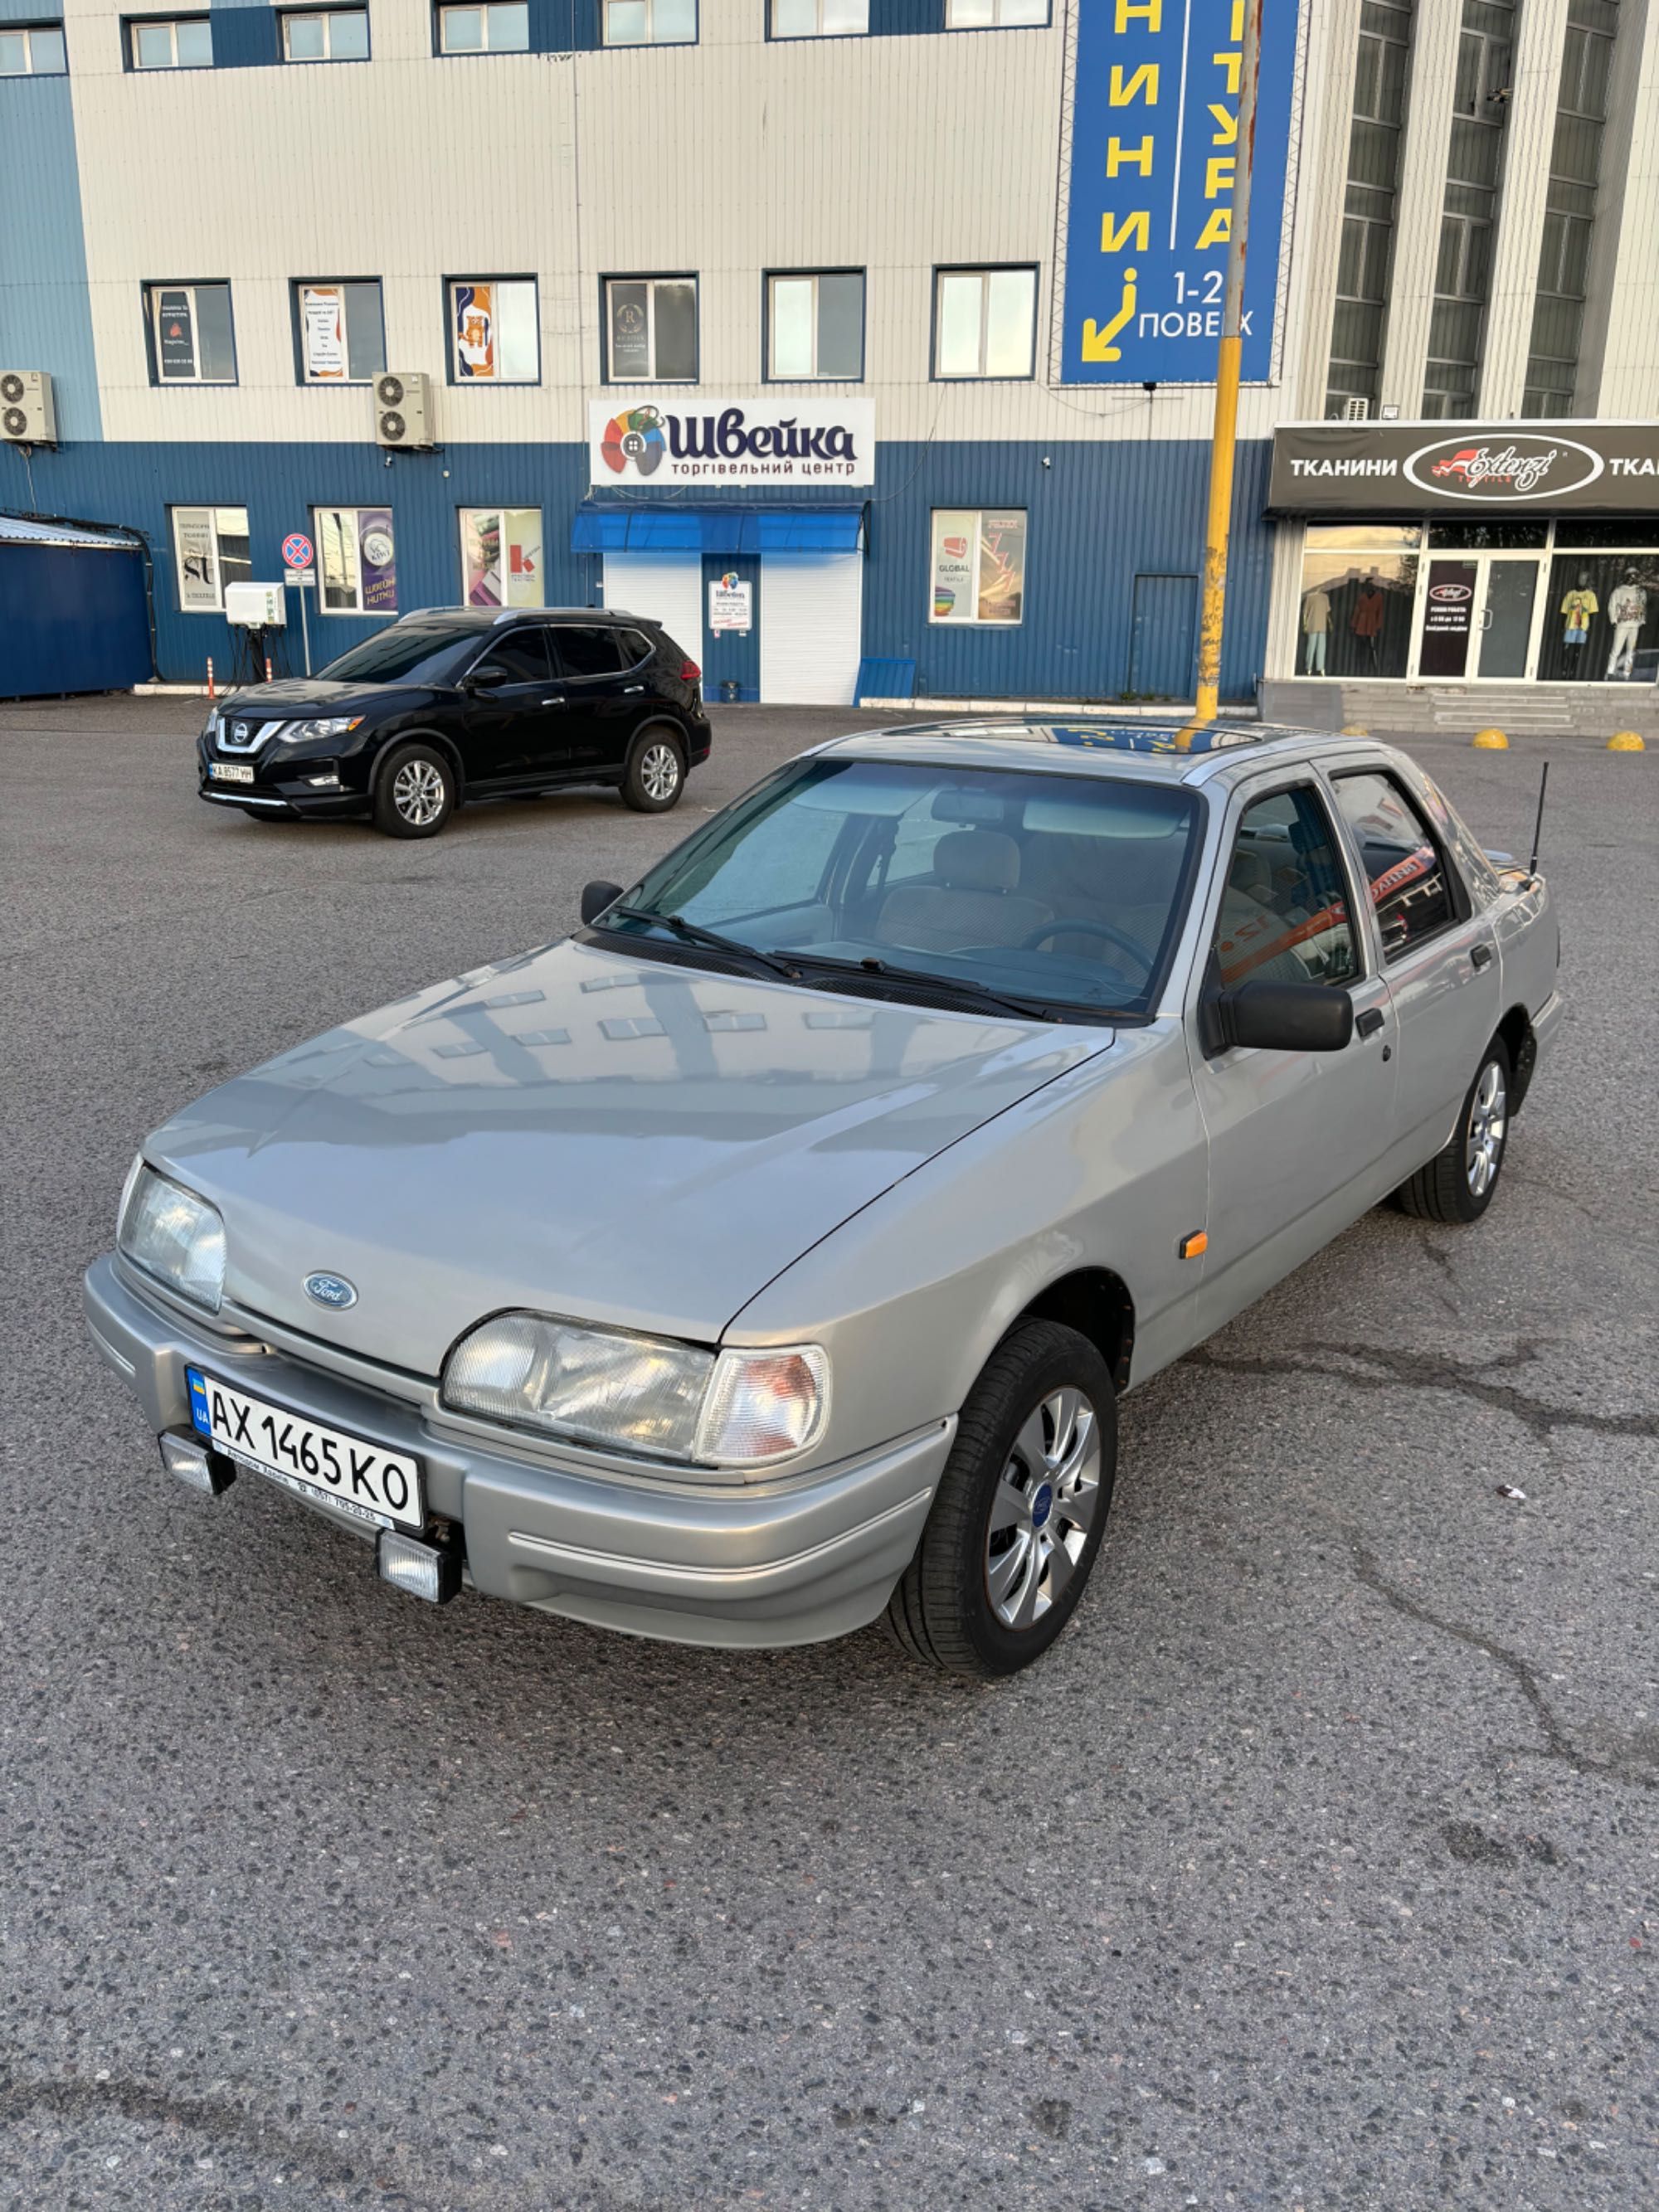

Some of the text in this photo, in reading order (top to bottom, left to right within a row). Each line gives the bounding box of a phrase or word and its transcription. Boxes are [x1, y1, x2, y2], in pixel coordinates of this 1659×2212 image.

[1174, 270, 1224, 304] 1-2
[1139, 310, 1253, 338] ПОВЕХ
[665, 407, 858, 460] Швейка
[672, 461, 855, 476] торгівельний центр
[1290, 459, 1399, 477] ТКАНИНИ
[1609, 458, 1659, 476] ТКА
[939, 564, 970, 573] GLOBAL
[314, 1279, 343, 1301] Ford
[196, 1407, 208, 1425] UA
[212, 1391, 409, 1511] AX 1465 KO
